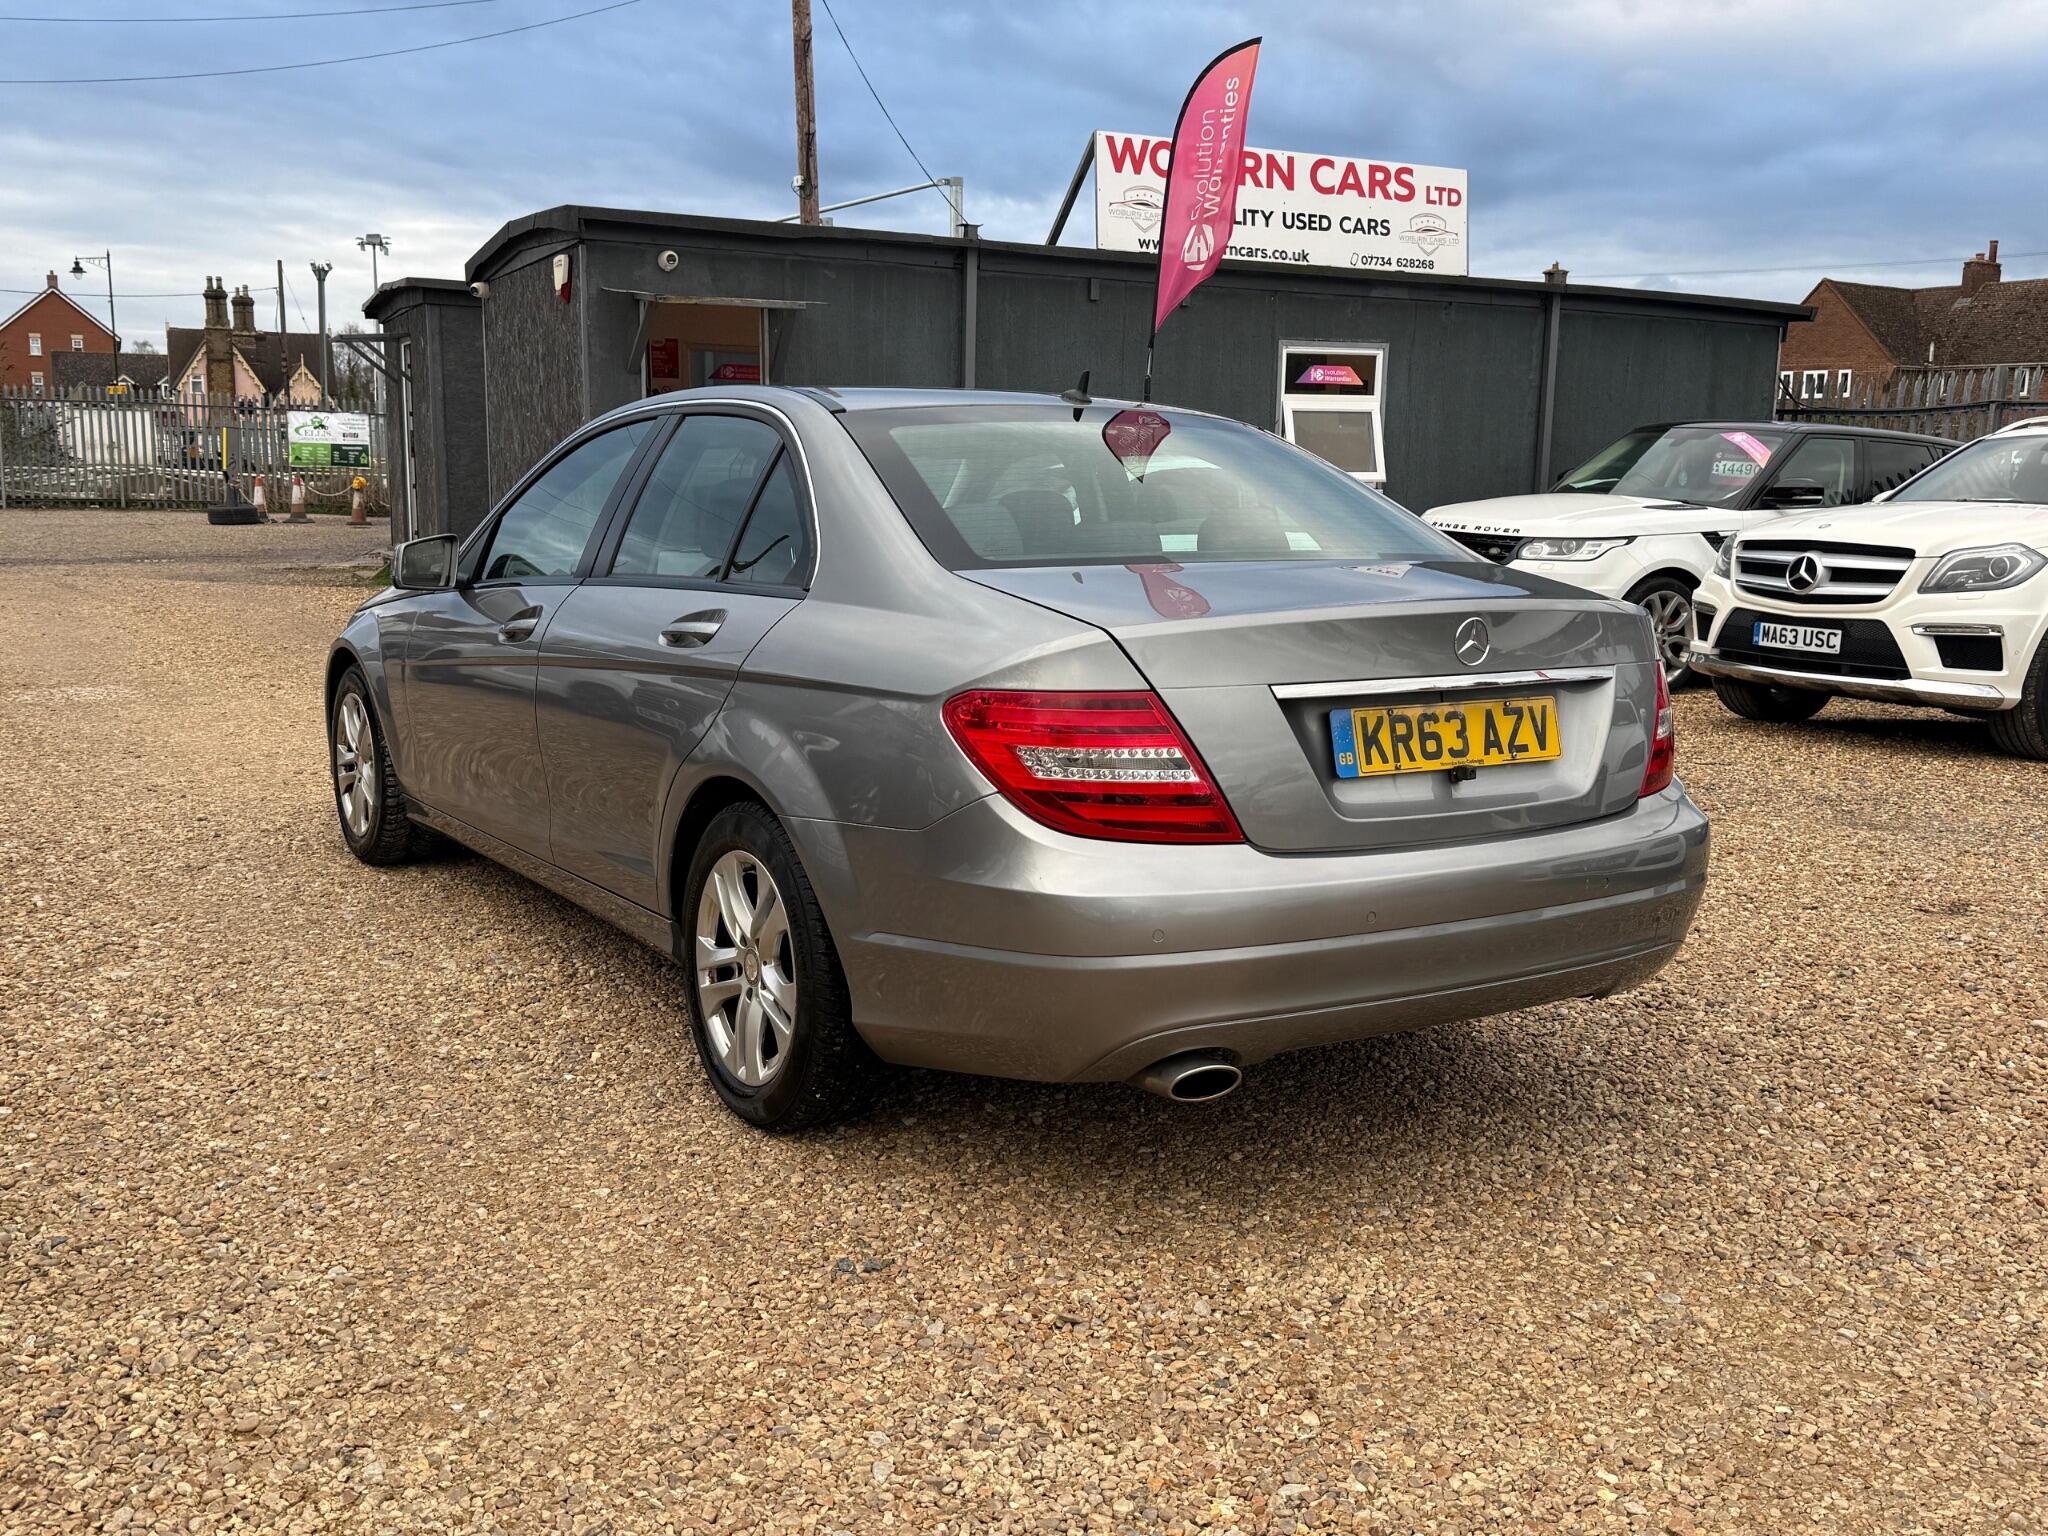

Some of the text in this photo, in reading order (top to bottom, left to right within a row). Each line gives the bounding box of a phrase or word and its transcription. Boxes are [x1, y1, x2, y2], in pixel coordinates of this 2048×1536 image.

[1105, 135, 1462, 208] WORN CARS LTD
[1282, 211, 1332, 232] USED
[1338, 215, 1391, 237] CARS
[1361, 255, 1435, 270] 07734 628268
[1431, 521, 1521, 534] RANGE ROVER
[1761, 625, 1838, 649] MA63 USC
[1360, 704, 1548, 766] KR63 AZV
[1338, 752, 1354, 765] GB
